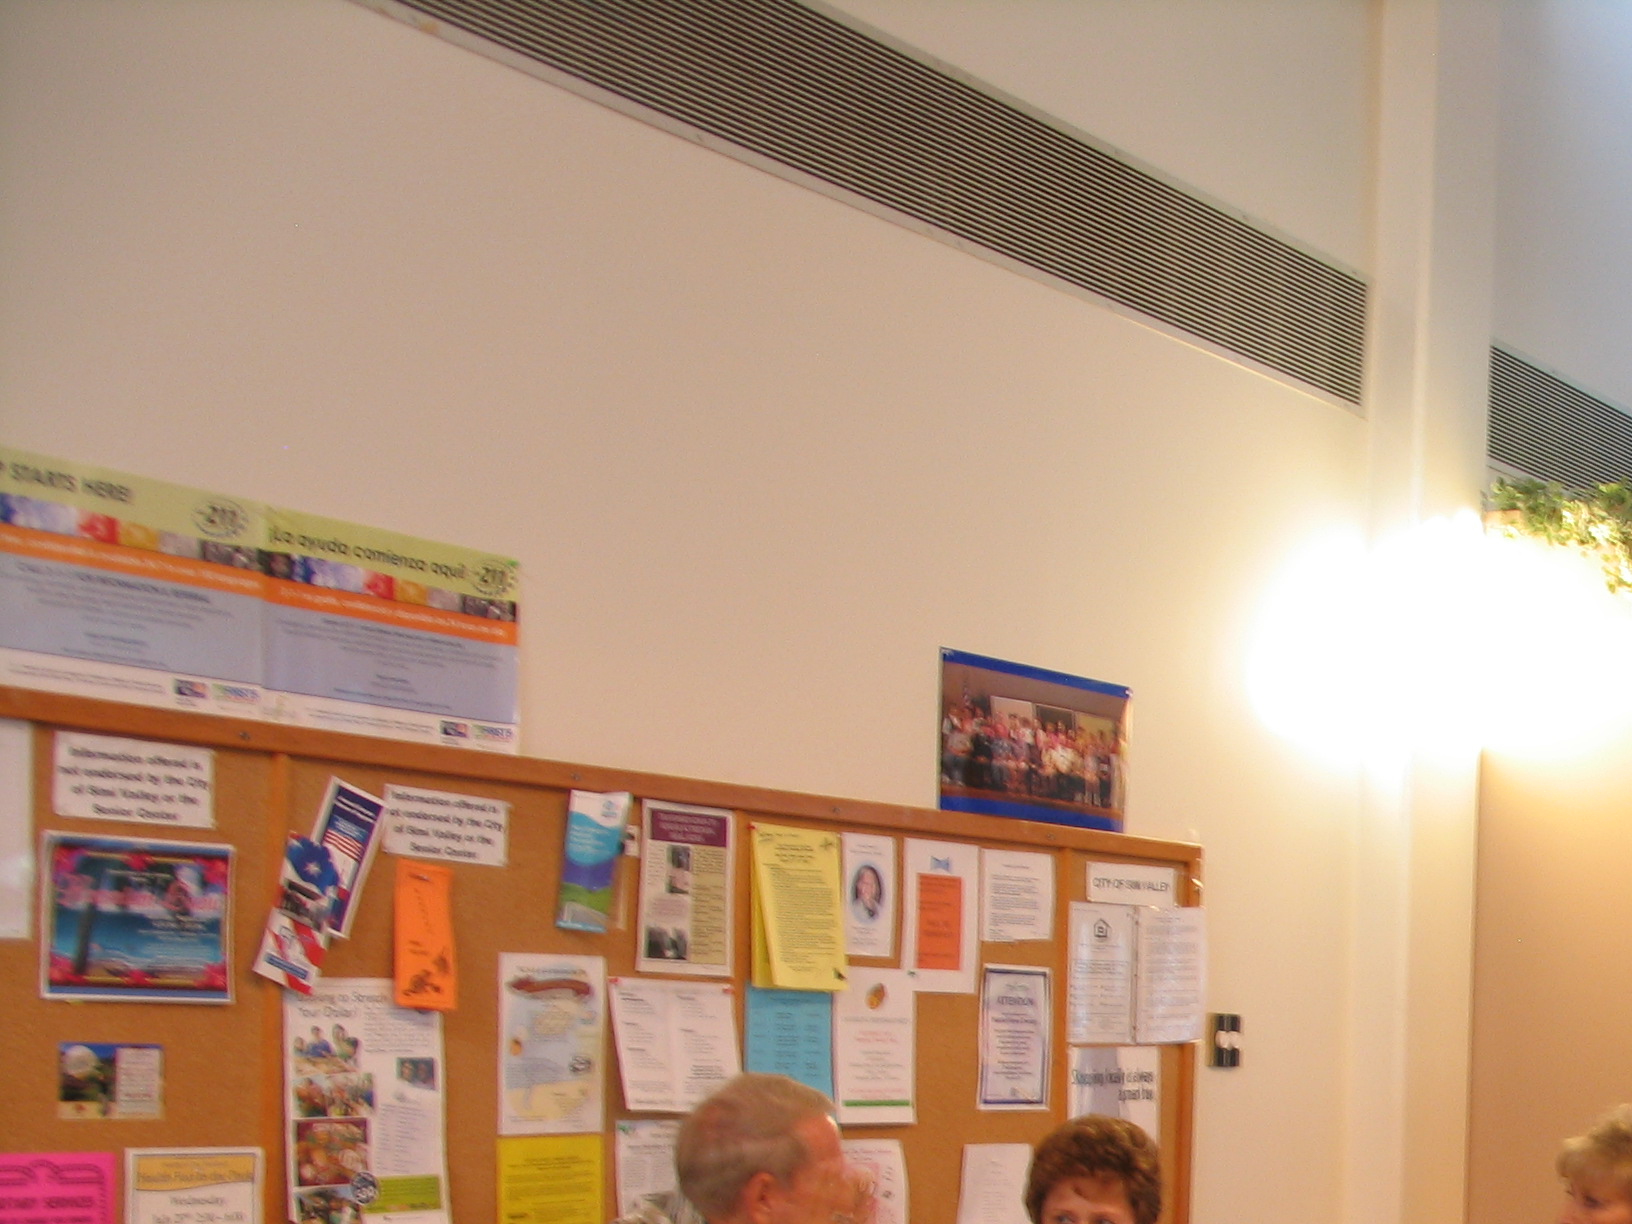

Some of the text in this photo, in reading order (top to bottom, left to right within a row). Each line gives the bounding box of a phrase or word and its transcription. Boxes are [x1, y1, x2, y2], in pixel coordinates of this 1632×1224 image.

[10, 461, 77, 493] STARTS
[298, 534, 348, 556] ayuda
[353, 545, 425, 572] comienza
[68, 747, 143, 764] Information
[146, 755, 188, 769] offered
[83, 767, 144, 783] endorsed
[147, 773, 161, 786] by
[164, 774, 184, 786] the
[186, 776, 209, 791] City
[87, 784, 117, 797] Simi
[119, 787, 159, 803] Valley
[178, 794, 200, 805] the
[391, 791, 451, 806] Information
[452, 800, 487, 813] offered
[92, 803, 179, 821] Senior Center
[402, 810, 451, 824] endorsed
[466, 817, 481, 827] the
[484, 819, 503, 832] City
[406, 825, 429, 836] Simi
[432, 829, 461, 842] Valley
[477, 834, 493, 845] the
[410, 841, 441, 854] Senior
[1093, 877, 1112, 889] CITY
[1114, 879, 1125, 888] OF
[170, 1195, 226, 1208] Wednesday
